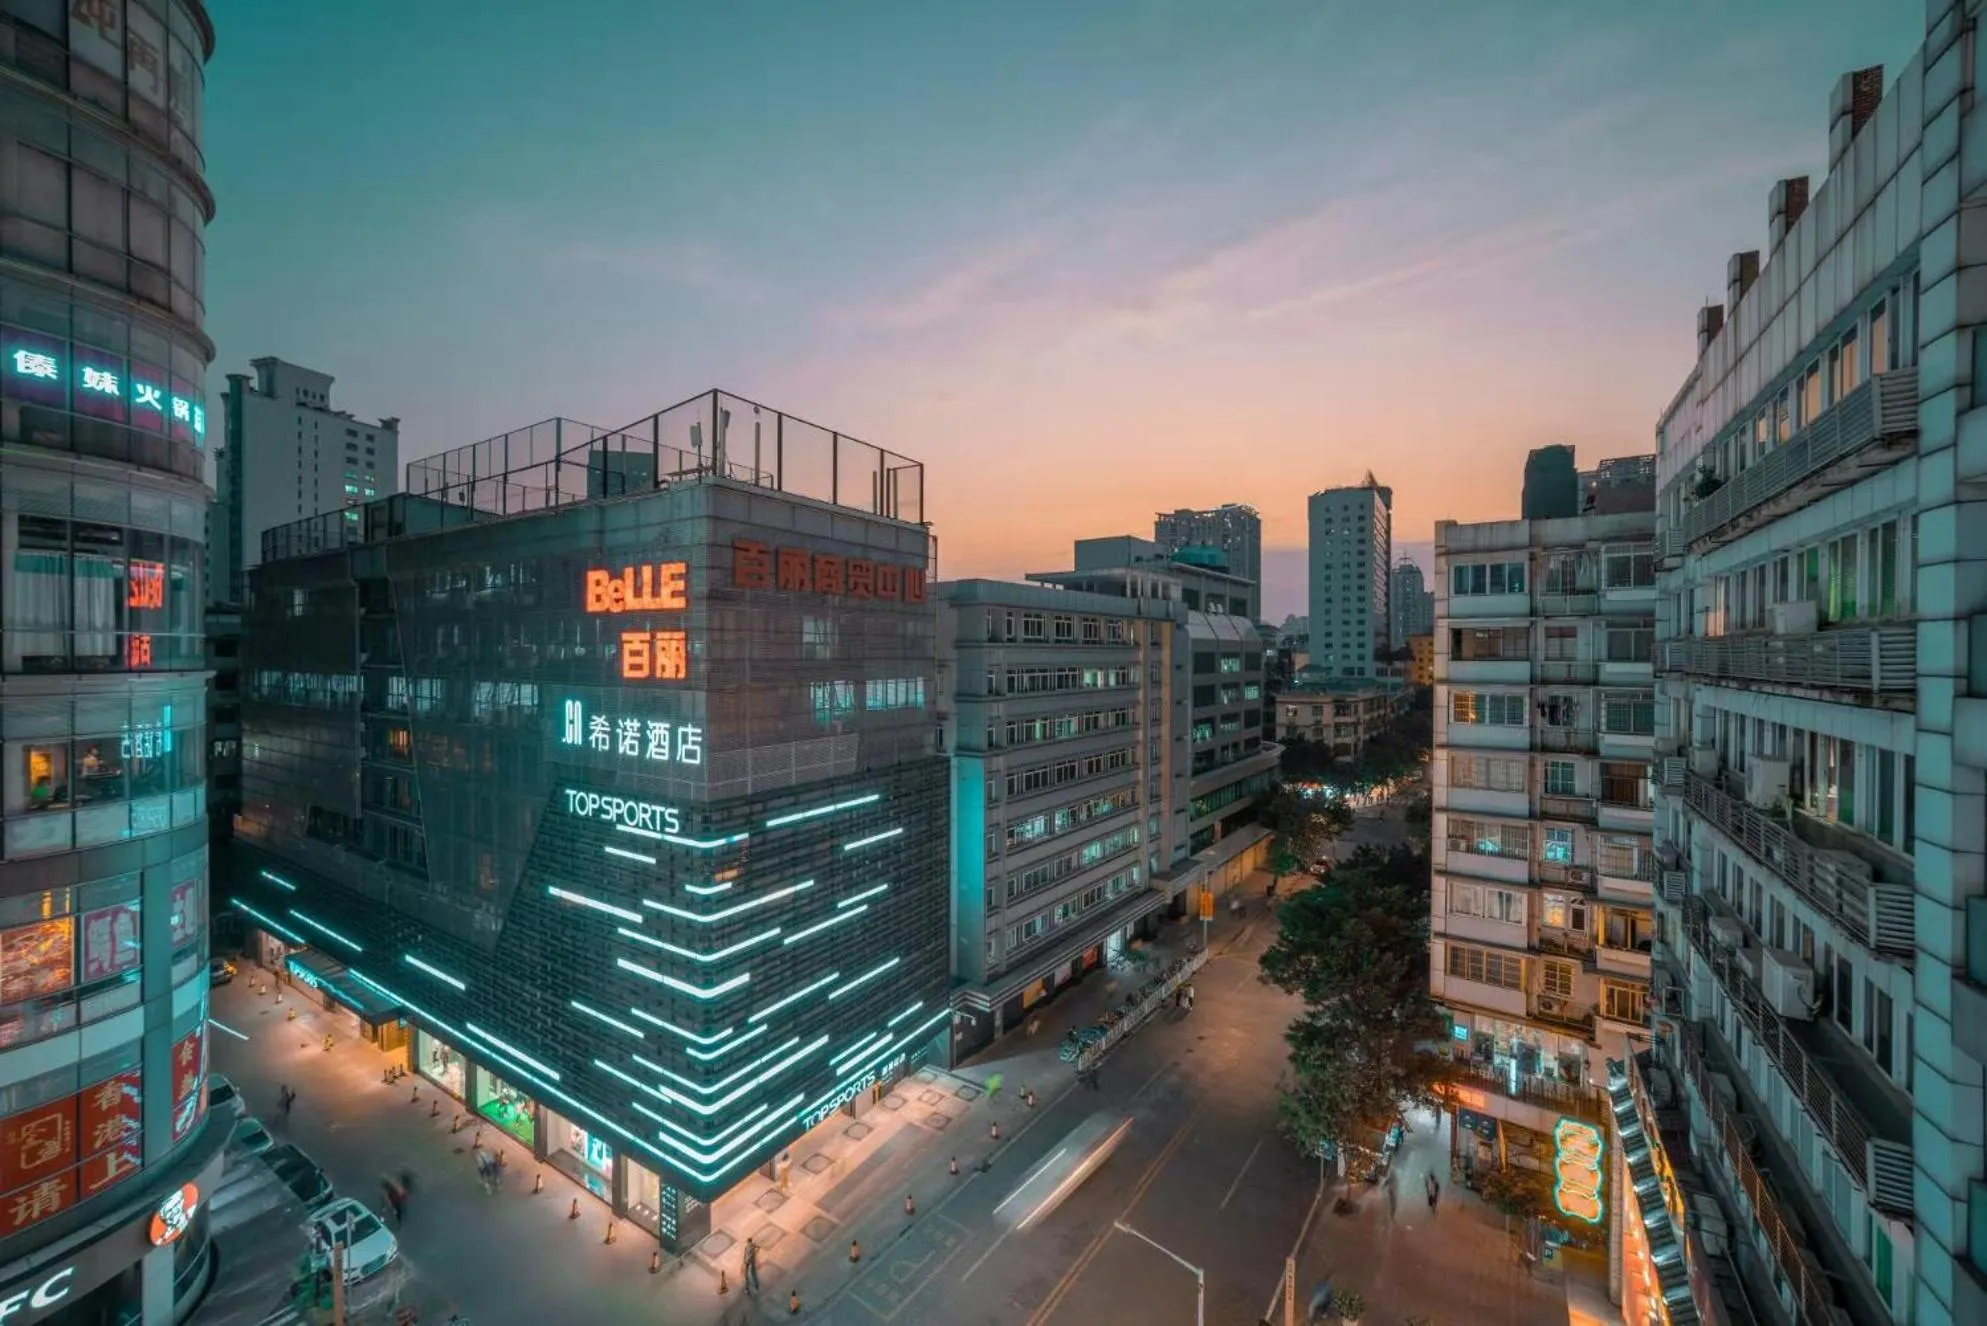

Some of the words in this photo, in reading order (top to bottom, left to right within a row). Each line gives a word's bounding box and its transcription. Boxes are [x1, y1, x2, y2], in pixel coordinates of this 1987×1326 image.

[733, 540, 926, 604] 百丽商贸中心
[621, 632, 687, 680] 百丽
[588, 715, 702, 765] 希诺酒店
[565, 789, 680, 834] TOPSPORTS
[802, 1070, 876, 1131] TOPSPORTS
